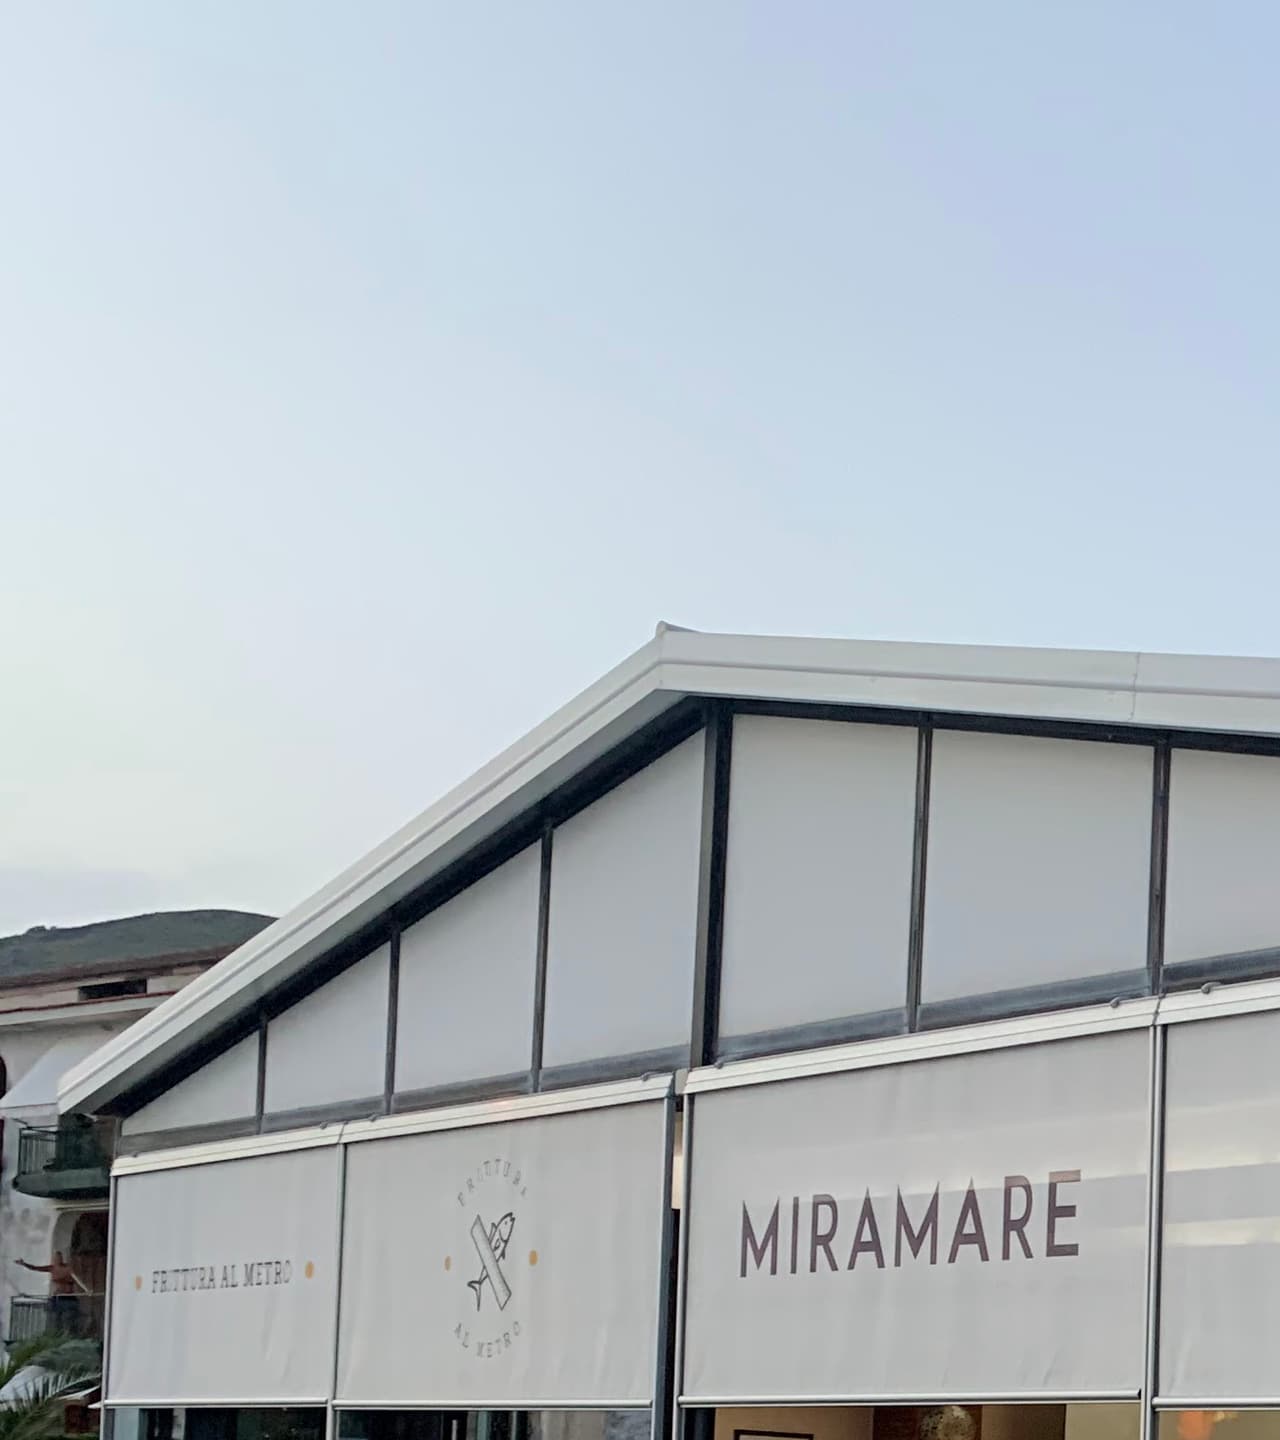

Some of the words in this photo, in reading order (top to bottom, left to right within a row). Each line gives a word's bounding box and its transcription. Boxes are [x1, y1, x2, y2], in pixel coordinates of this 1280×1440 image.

[739, 1169, 1082, 1278] MIRAMARE
[220, 1264, 238, 1288] AL
[243, 1260, 292, 1287] METRO
